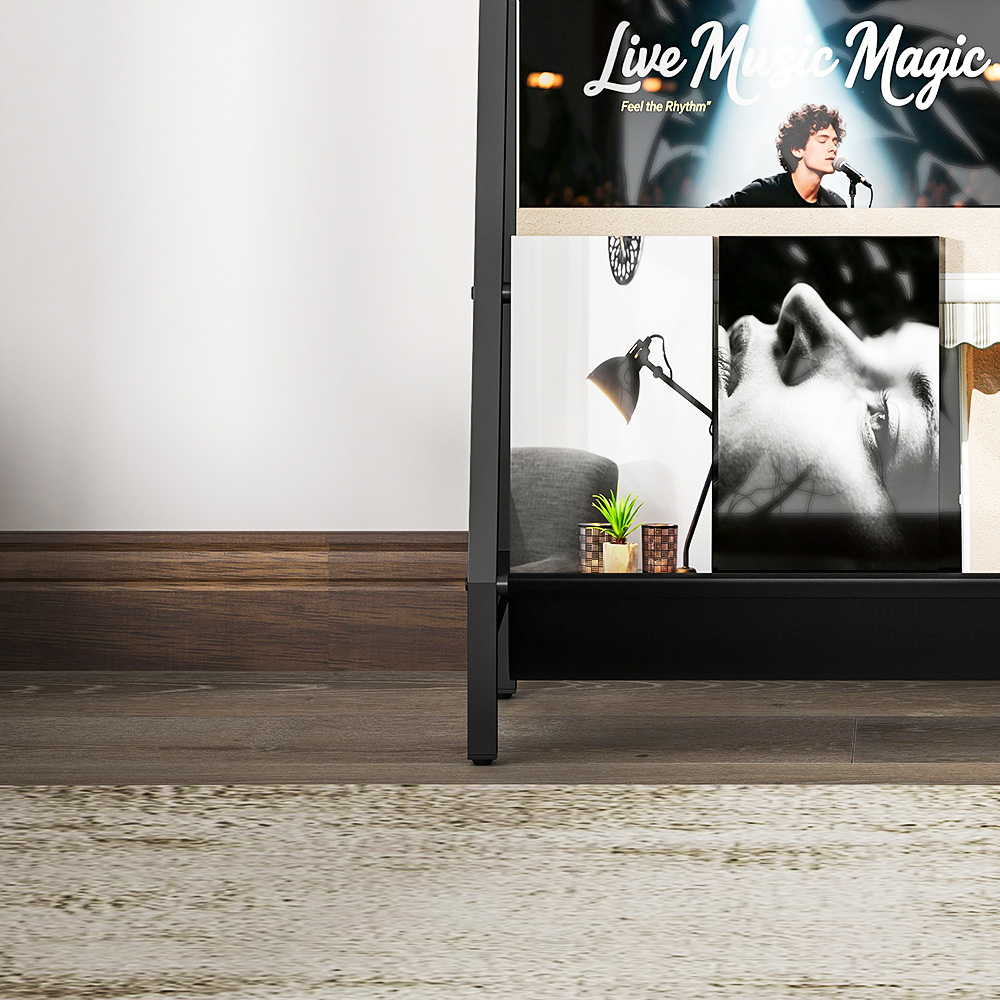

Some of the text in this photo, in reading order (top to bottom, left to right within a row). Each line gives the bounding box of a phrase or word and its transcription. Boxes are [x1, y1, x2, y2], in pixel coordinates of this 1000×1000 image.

[583, 20, 992, 111] Live Music Magic
[621, 100, 644, 112] Feel
[645, 100, 664, 112] the
